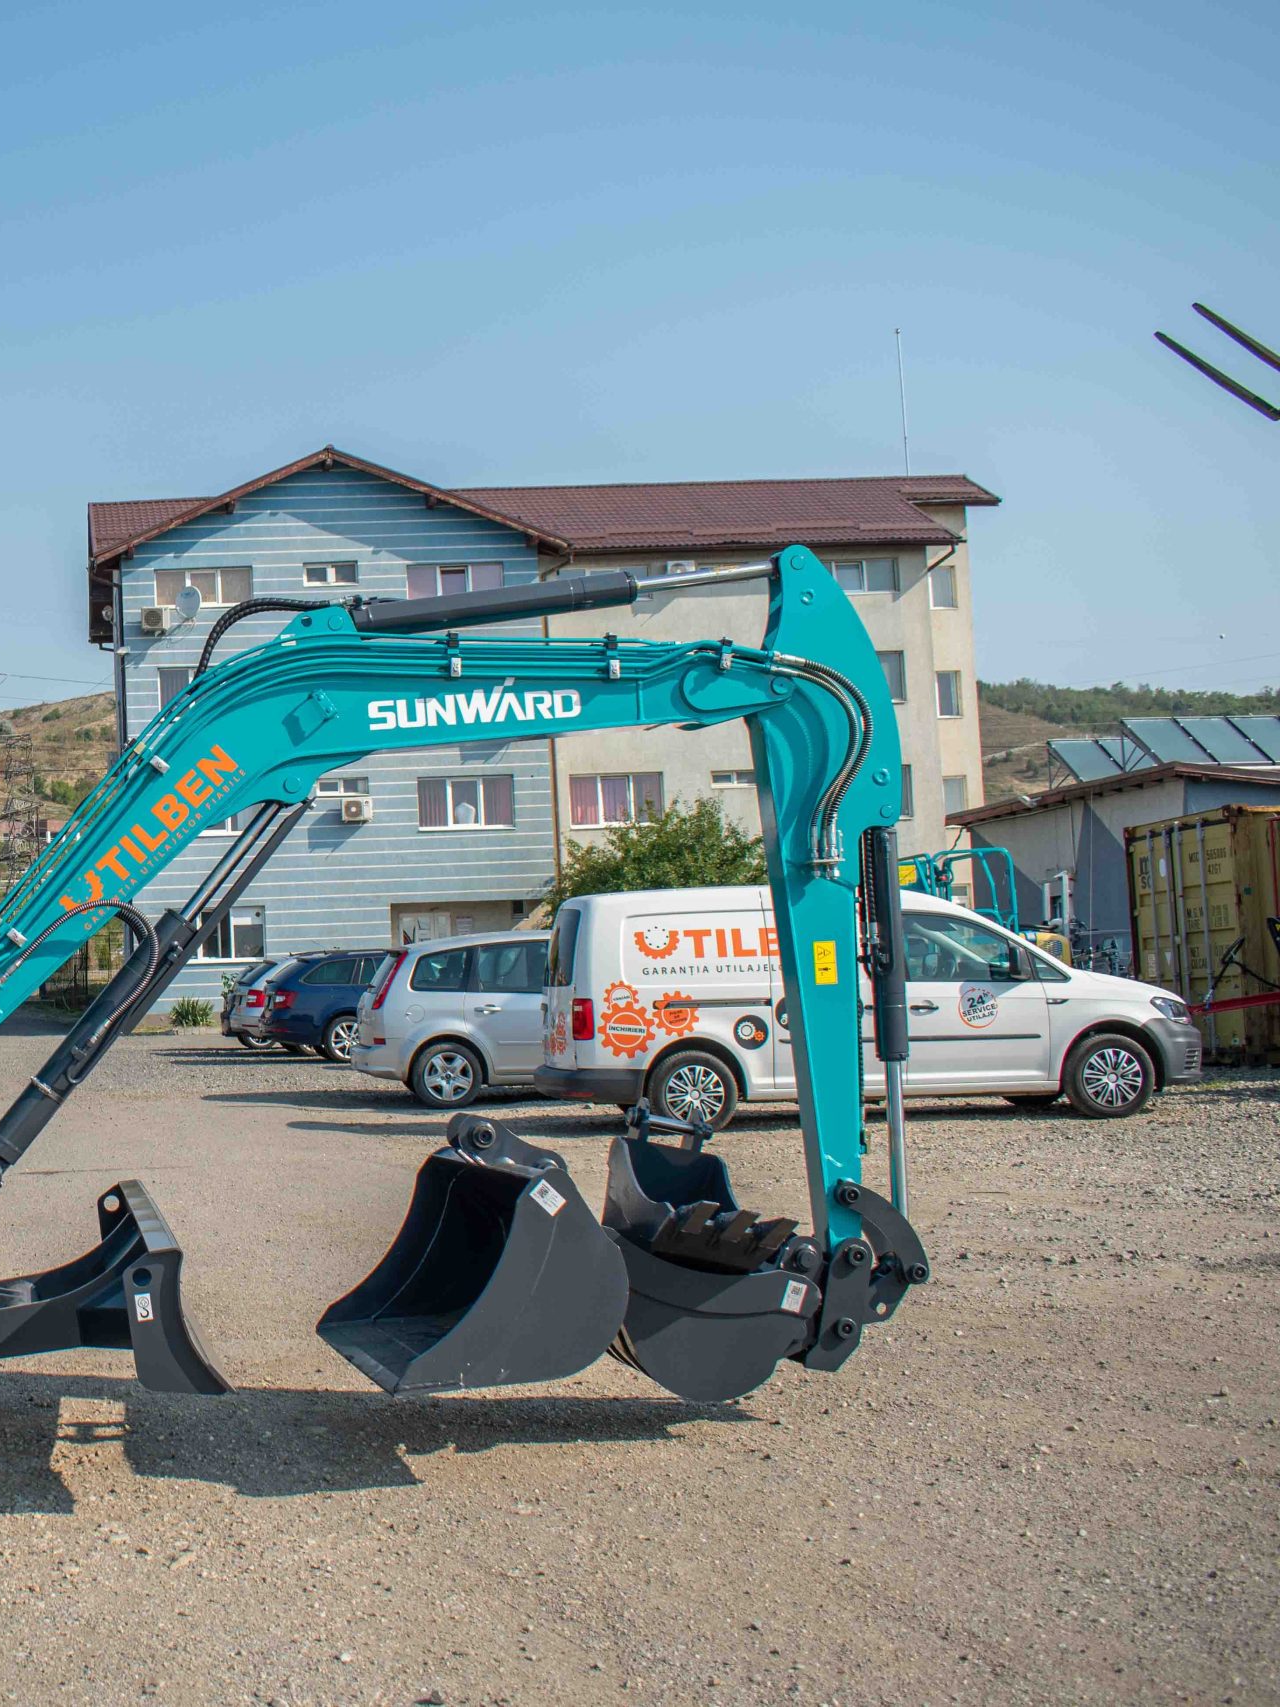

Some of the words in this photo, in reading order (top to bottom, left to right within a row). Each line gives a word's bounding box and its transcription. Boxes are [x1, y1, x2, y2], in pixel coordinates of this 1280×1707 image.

[368, 677, 581, 731] SUNWARD
[59, 744, 238, 914] UTILBEN
[963, 1003, 996, 1017] SERVICE
